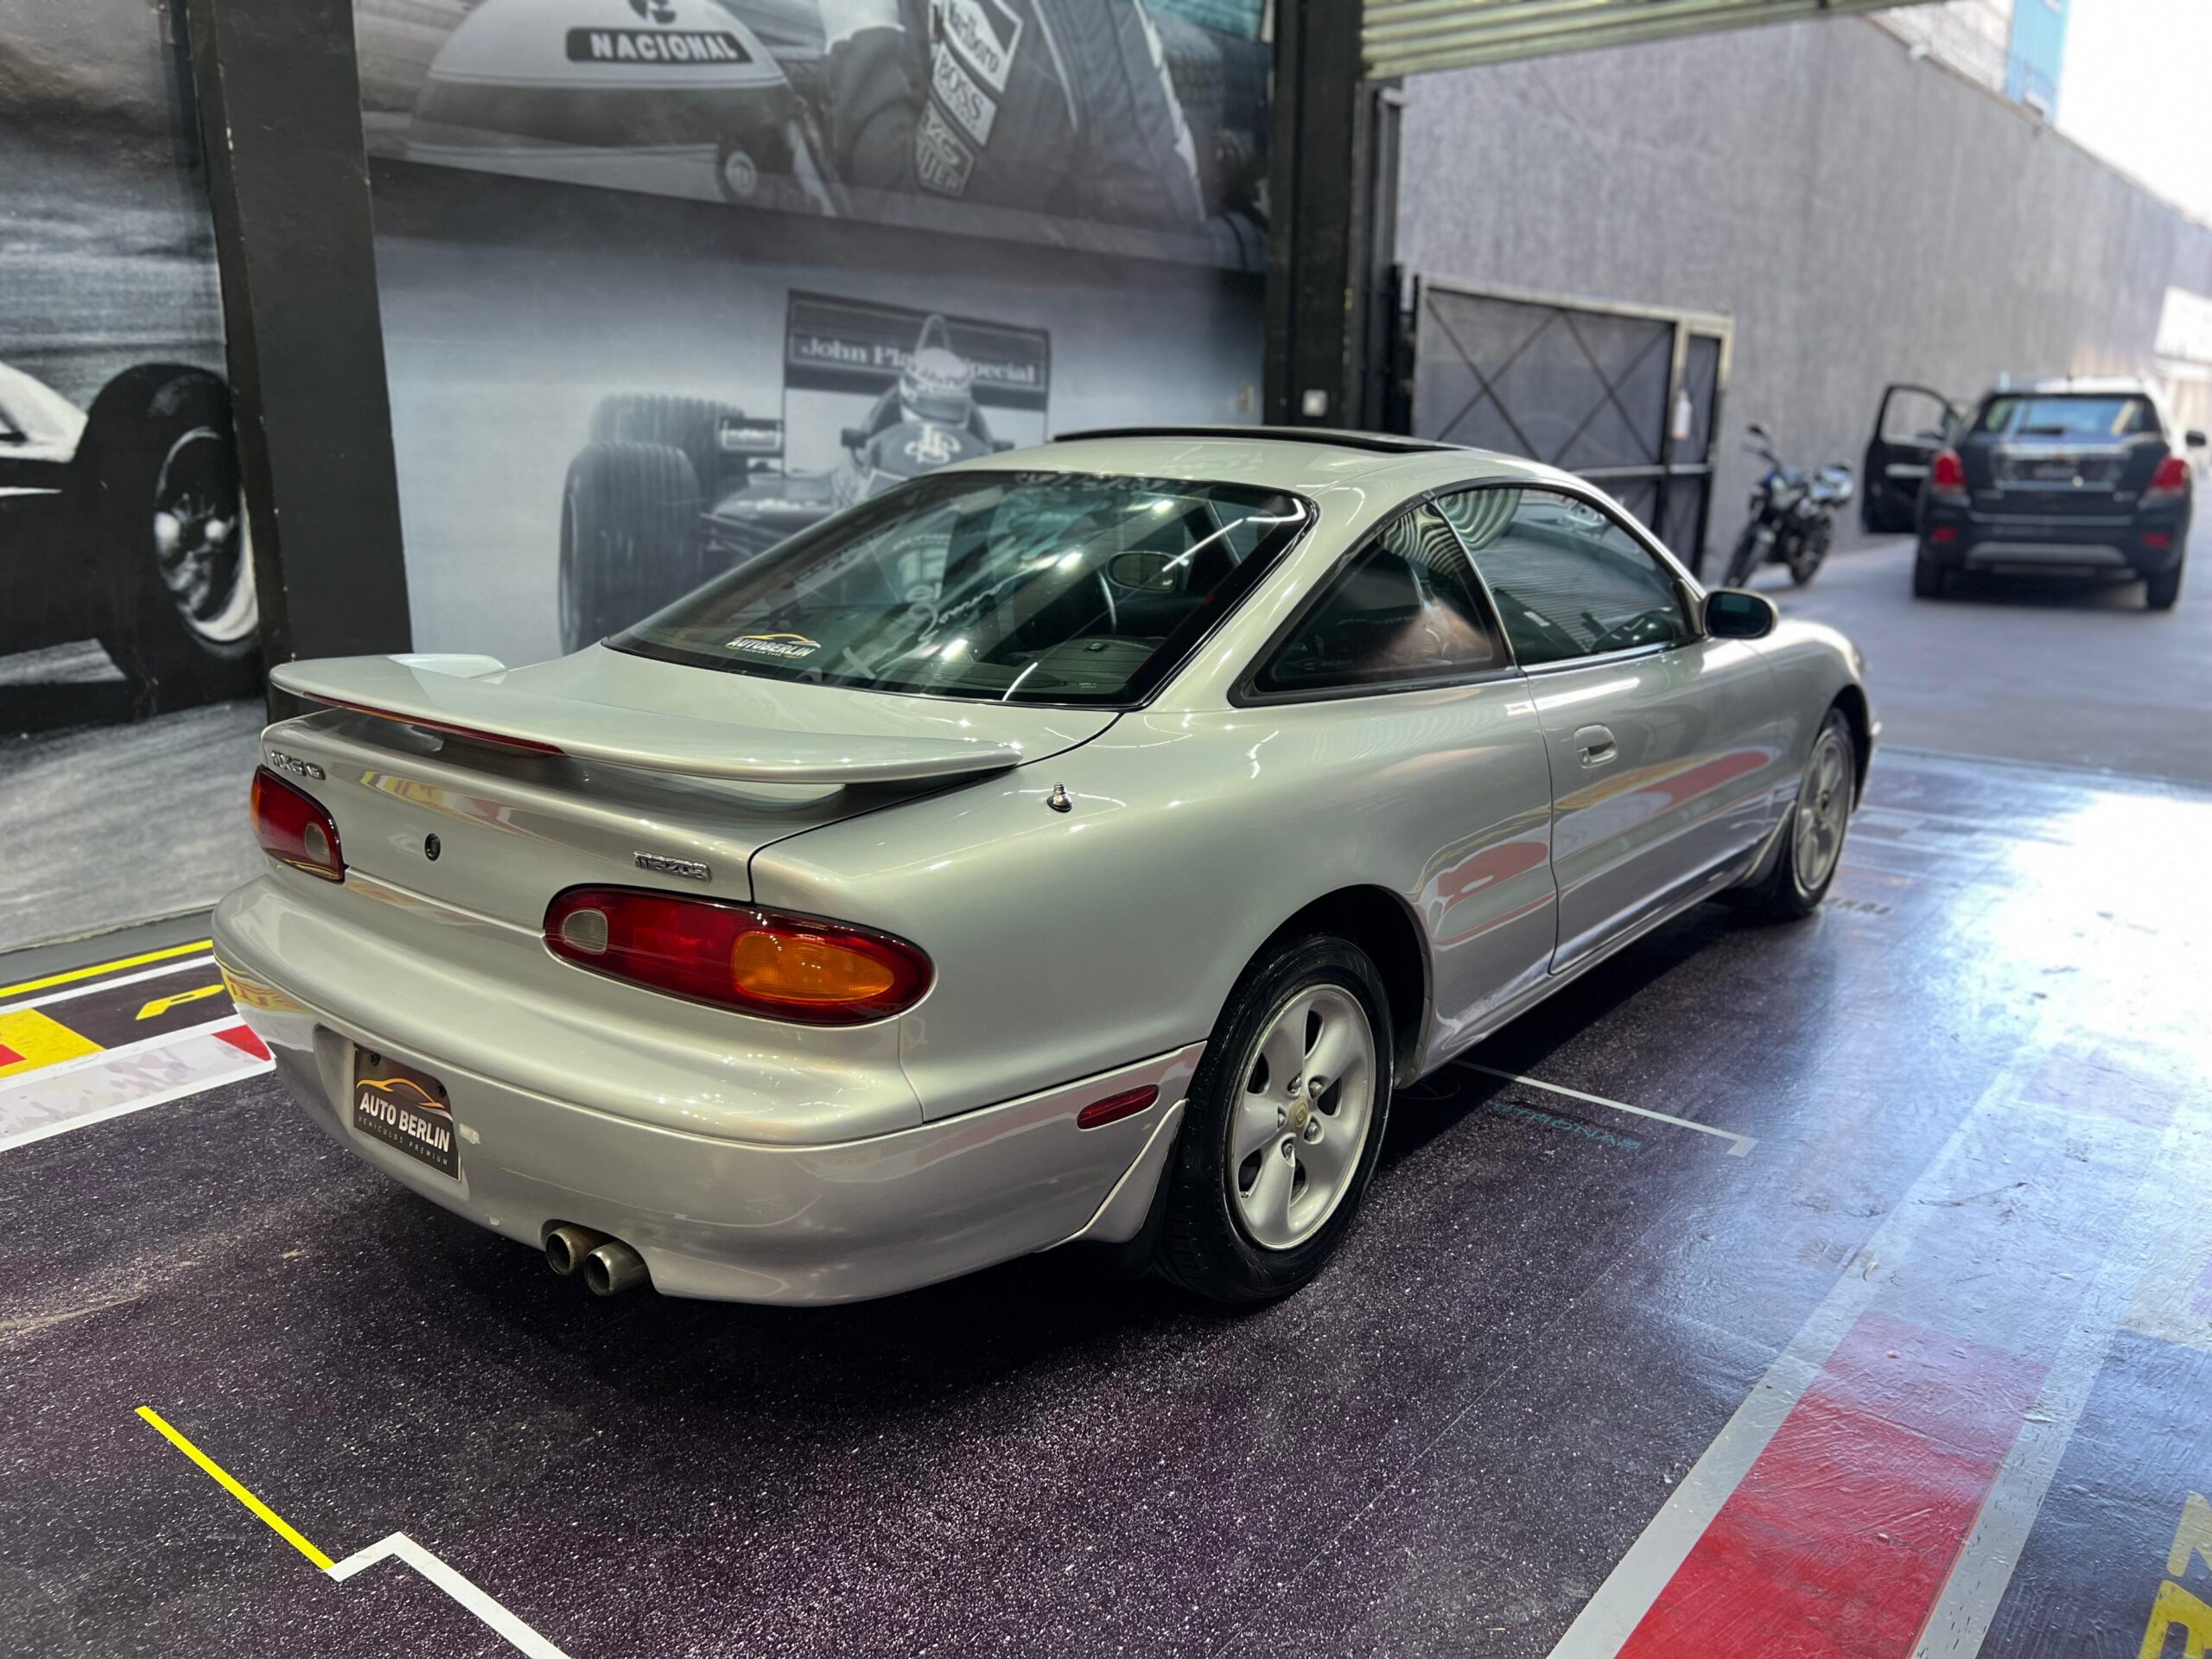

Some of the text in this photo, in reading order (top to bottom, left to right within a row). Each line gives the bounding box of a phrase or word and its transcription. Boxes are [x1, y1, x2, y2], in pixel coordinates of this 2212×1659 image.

[590, 32, 738, 60] NACIONAL
[938, 49, 982, 121] BOSS
[800, 336, 868, 365] John
[965, 357, 1036, 383] pecial
[359, 1091, 450, 1153] AUTO BERLIN
[409, 1141, 448, 1166] PREMIUM
